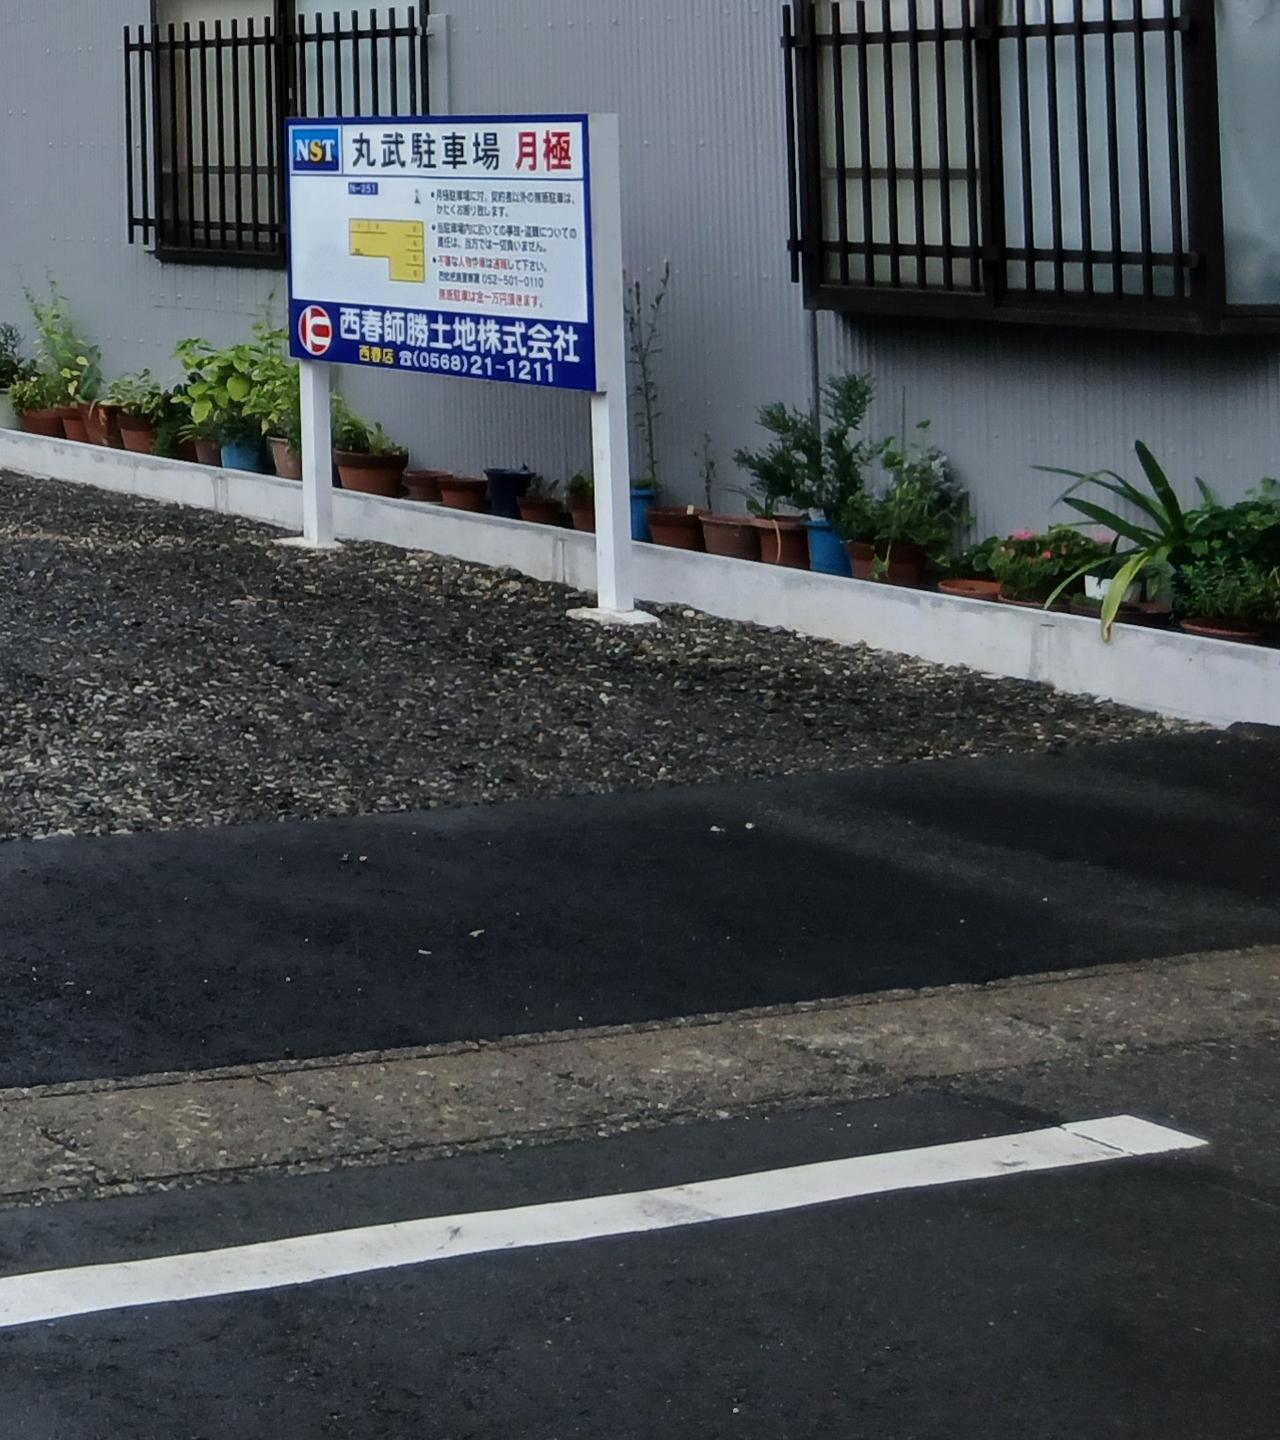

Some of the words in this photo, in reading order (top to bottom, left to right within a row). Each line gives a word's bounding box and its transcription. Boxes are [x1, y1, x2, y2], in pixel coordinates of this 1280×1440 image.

[295, 138, 336, 164] NST
[351, 131, 501, 171] 丸武駐車場
[515, 130, 572, 172] 月極
[339, 307, 580, 364] 西春師勝土地株式会社
[359, 344, 395, 365] 西春店
